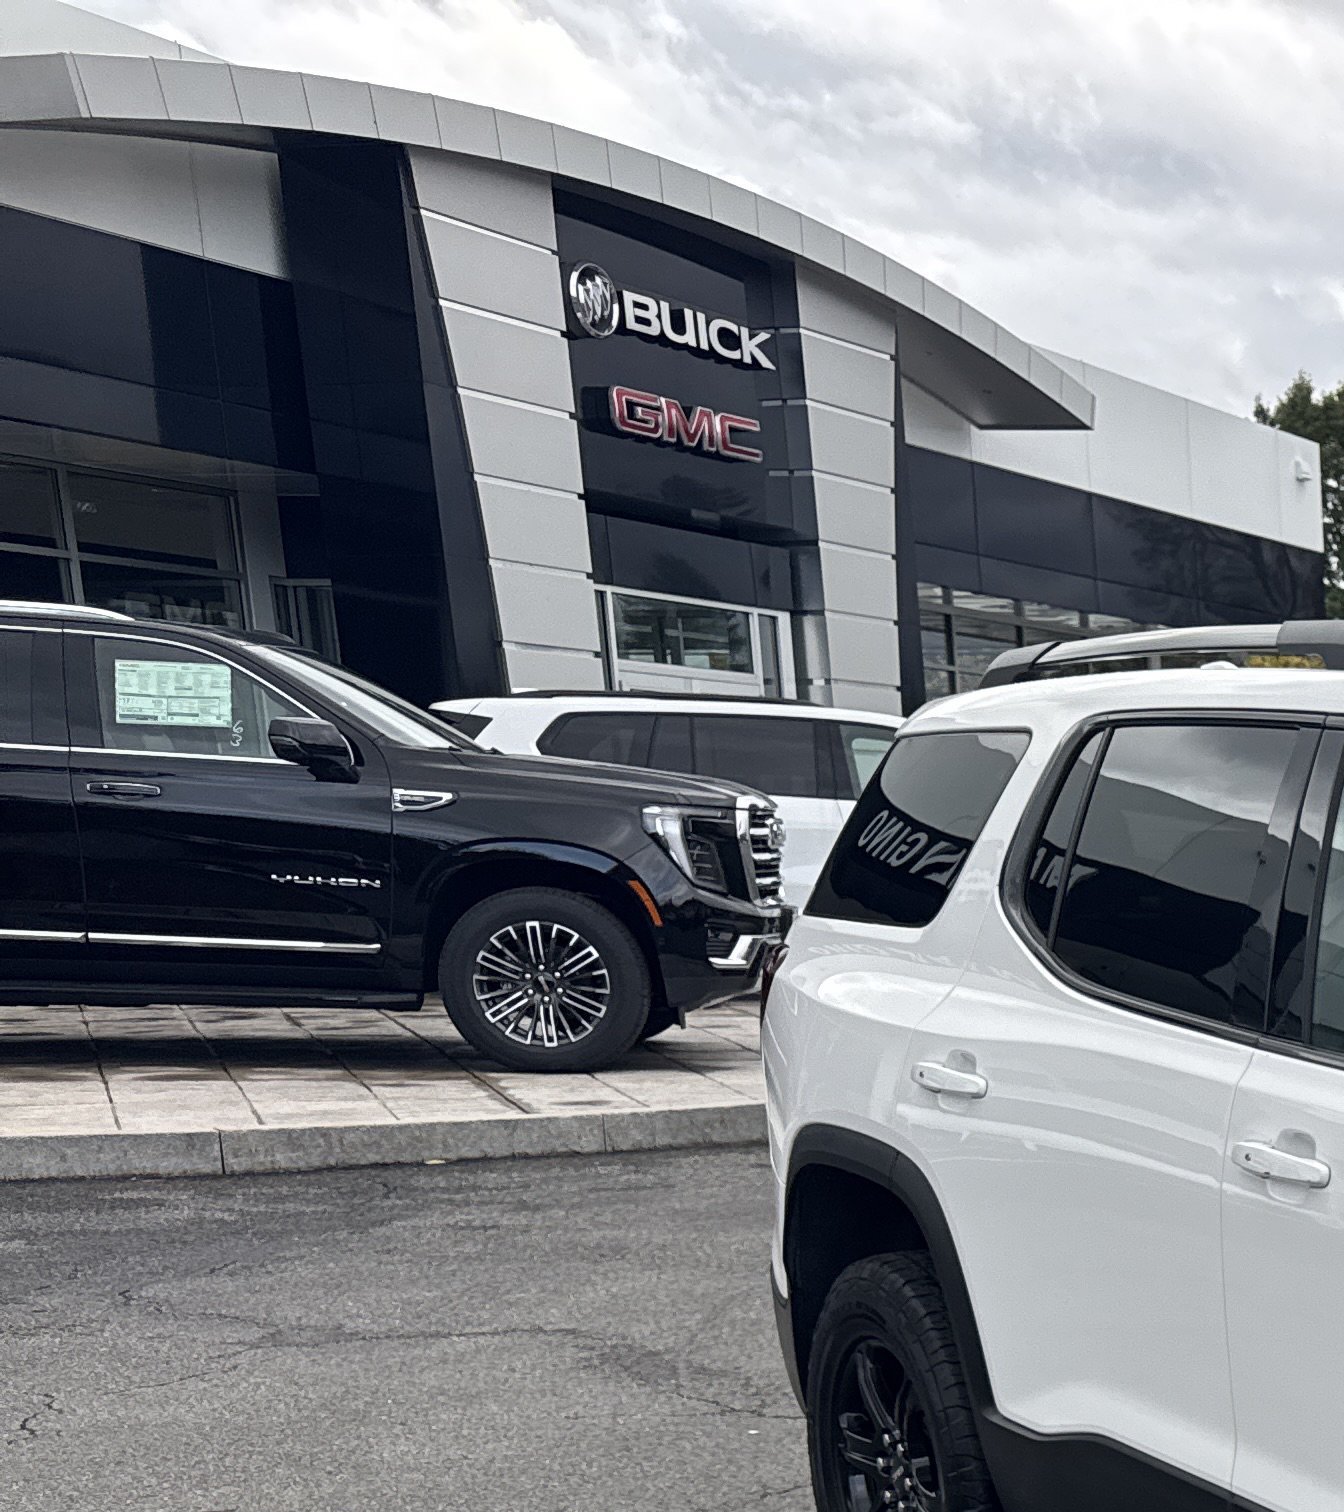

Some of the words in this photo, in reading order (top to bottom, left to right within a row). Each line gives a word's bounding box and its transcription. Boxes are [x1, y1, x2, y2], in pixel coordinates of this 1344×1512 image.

[622, 289, 777, 372] BUICK
[609, 384, 763, 463] GMC
[271, 874, 381, 888] YUKON
